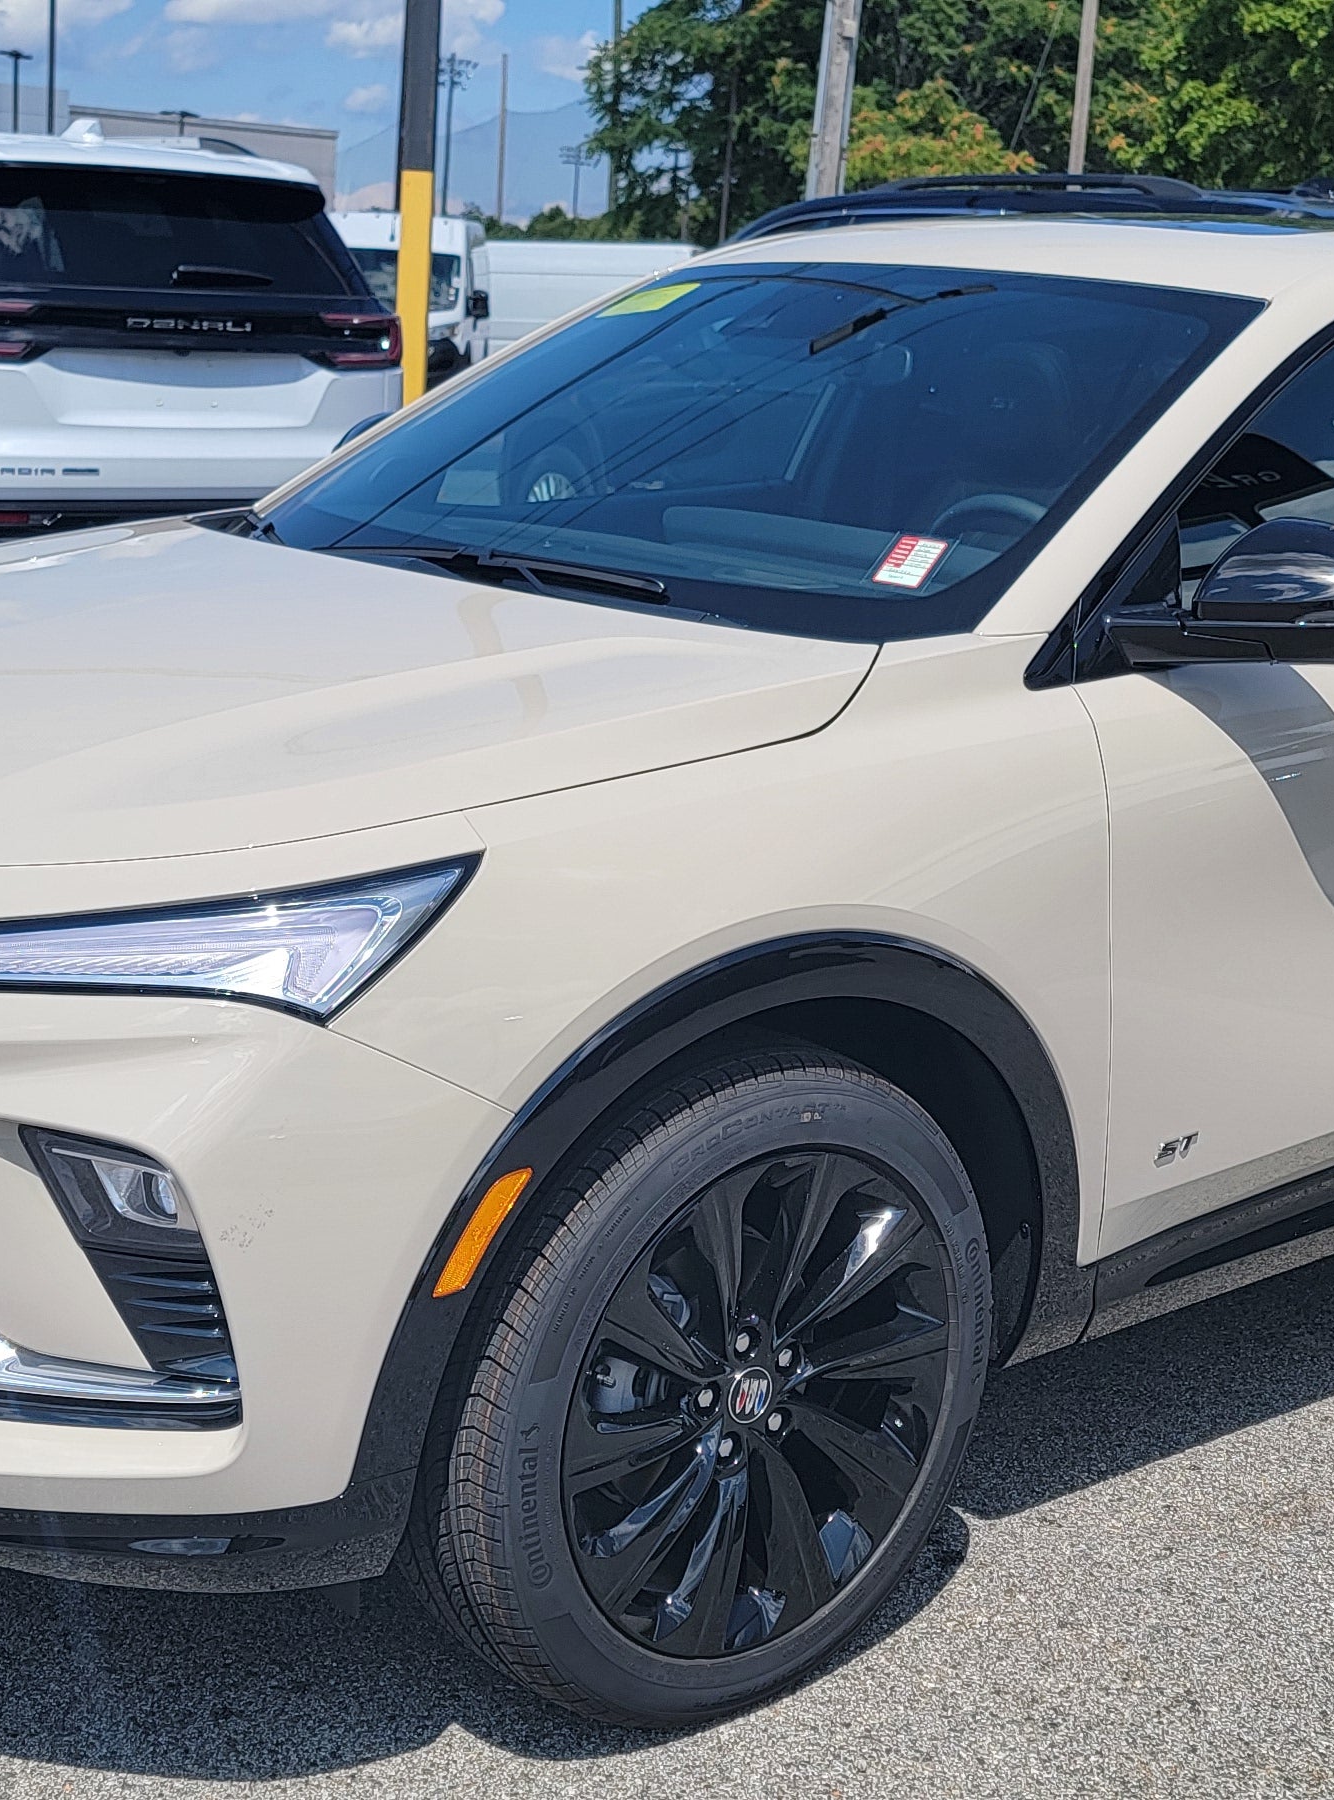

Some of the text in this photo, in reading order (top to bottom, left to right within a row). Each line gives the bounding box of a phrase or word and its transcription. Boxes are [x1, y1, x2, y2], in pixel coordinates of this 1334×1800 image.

[126, 316, 252, 332] DENALI
[1156, 1130, 1199, 1161] ST
[517, 1447, 554, 1590] Continental
